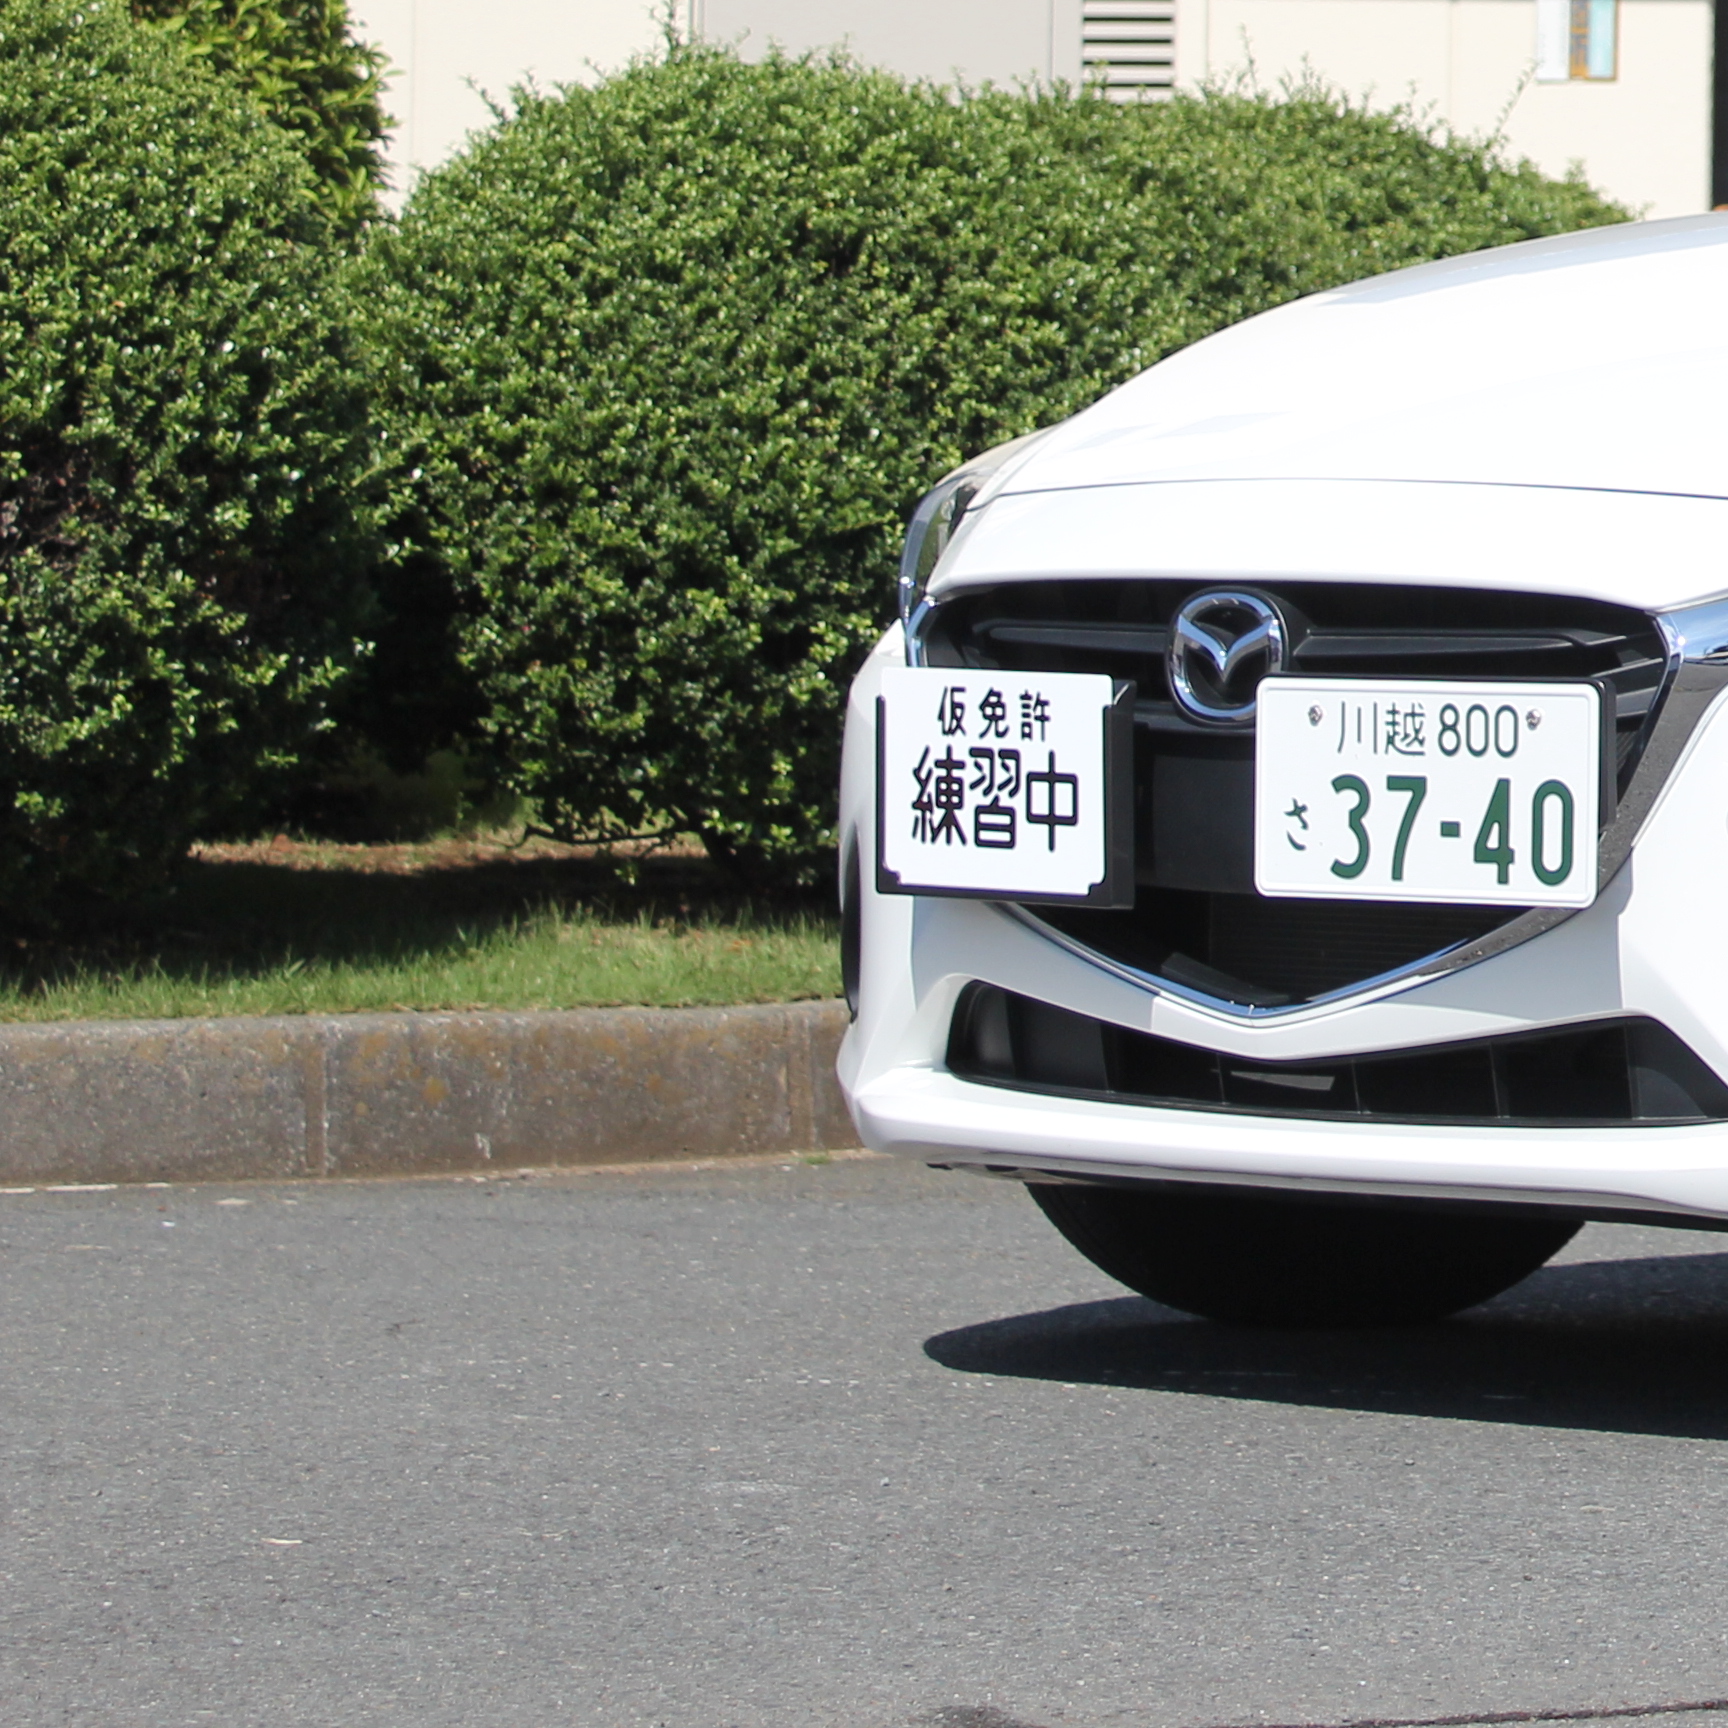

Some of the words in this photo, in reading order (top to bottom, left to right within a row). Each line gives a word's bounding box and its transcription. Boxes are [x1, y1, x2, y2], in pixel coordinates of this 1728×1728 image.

[938, 685, 1051, 743] 仮免許
[911, 745, 1080, 852] 練習中
[1283, 797, 1310, 852] さ
[1329, 773, 1575, 887] 37-40
